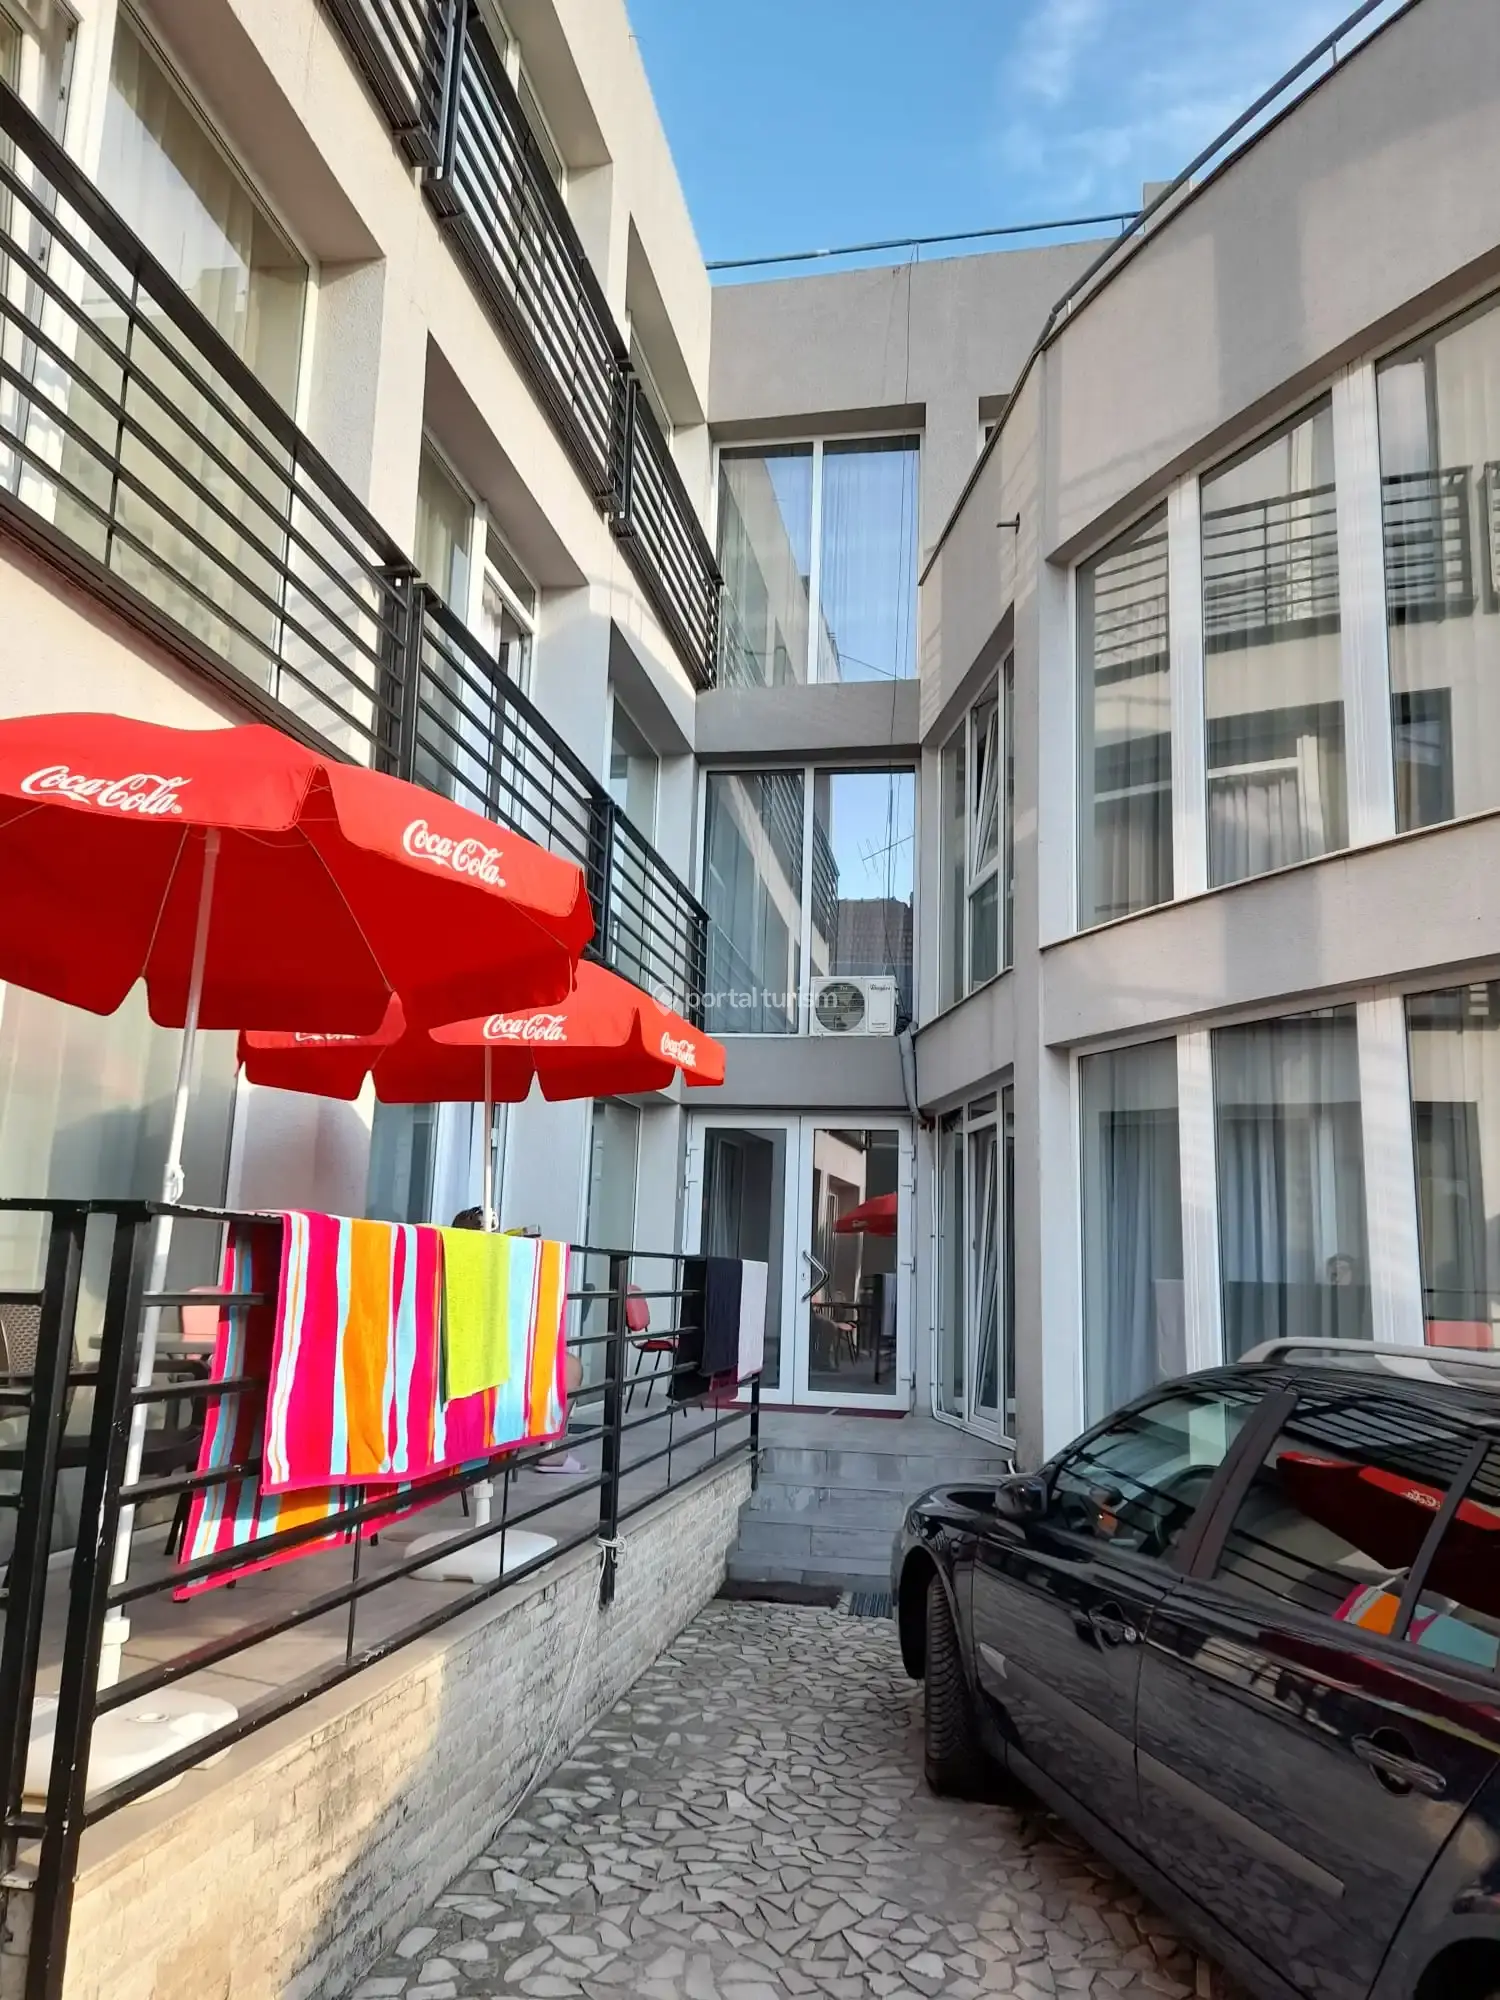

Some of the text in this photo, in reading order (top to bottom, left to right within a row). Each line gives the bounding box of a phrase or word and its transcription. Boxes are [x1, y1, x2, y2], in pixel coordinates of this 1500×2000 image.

[20, 765, 192, 815] Coca-Cola
[403, 819, 506, 888] Coca-Cola
[483, 1013, 568, 1041] Coca-Cola
